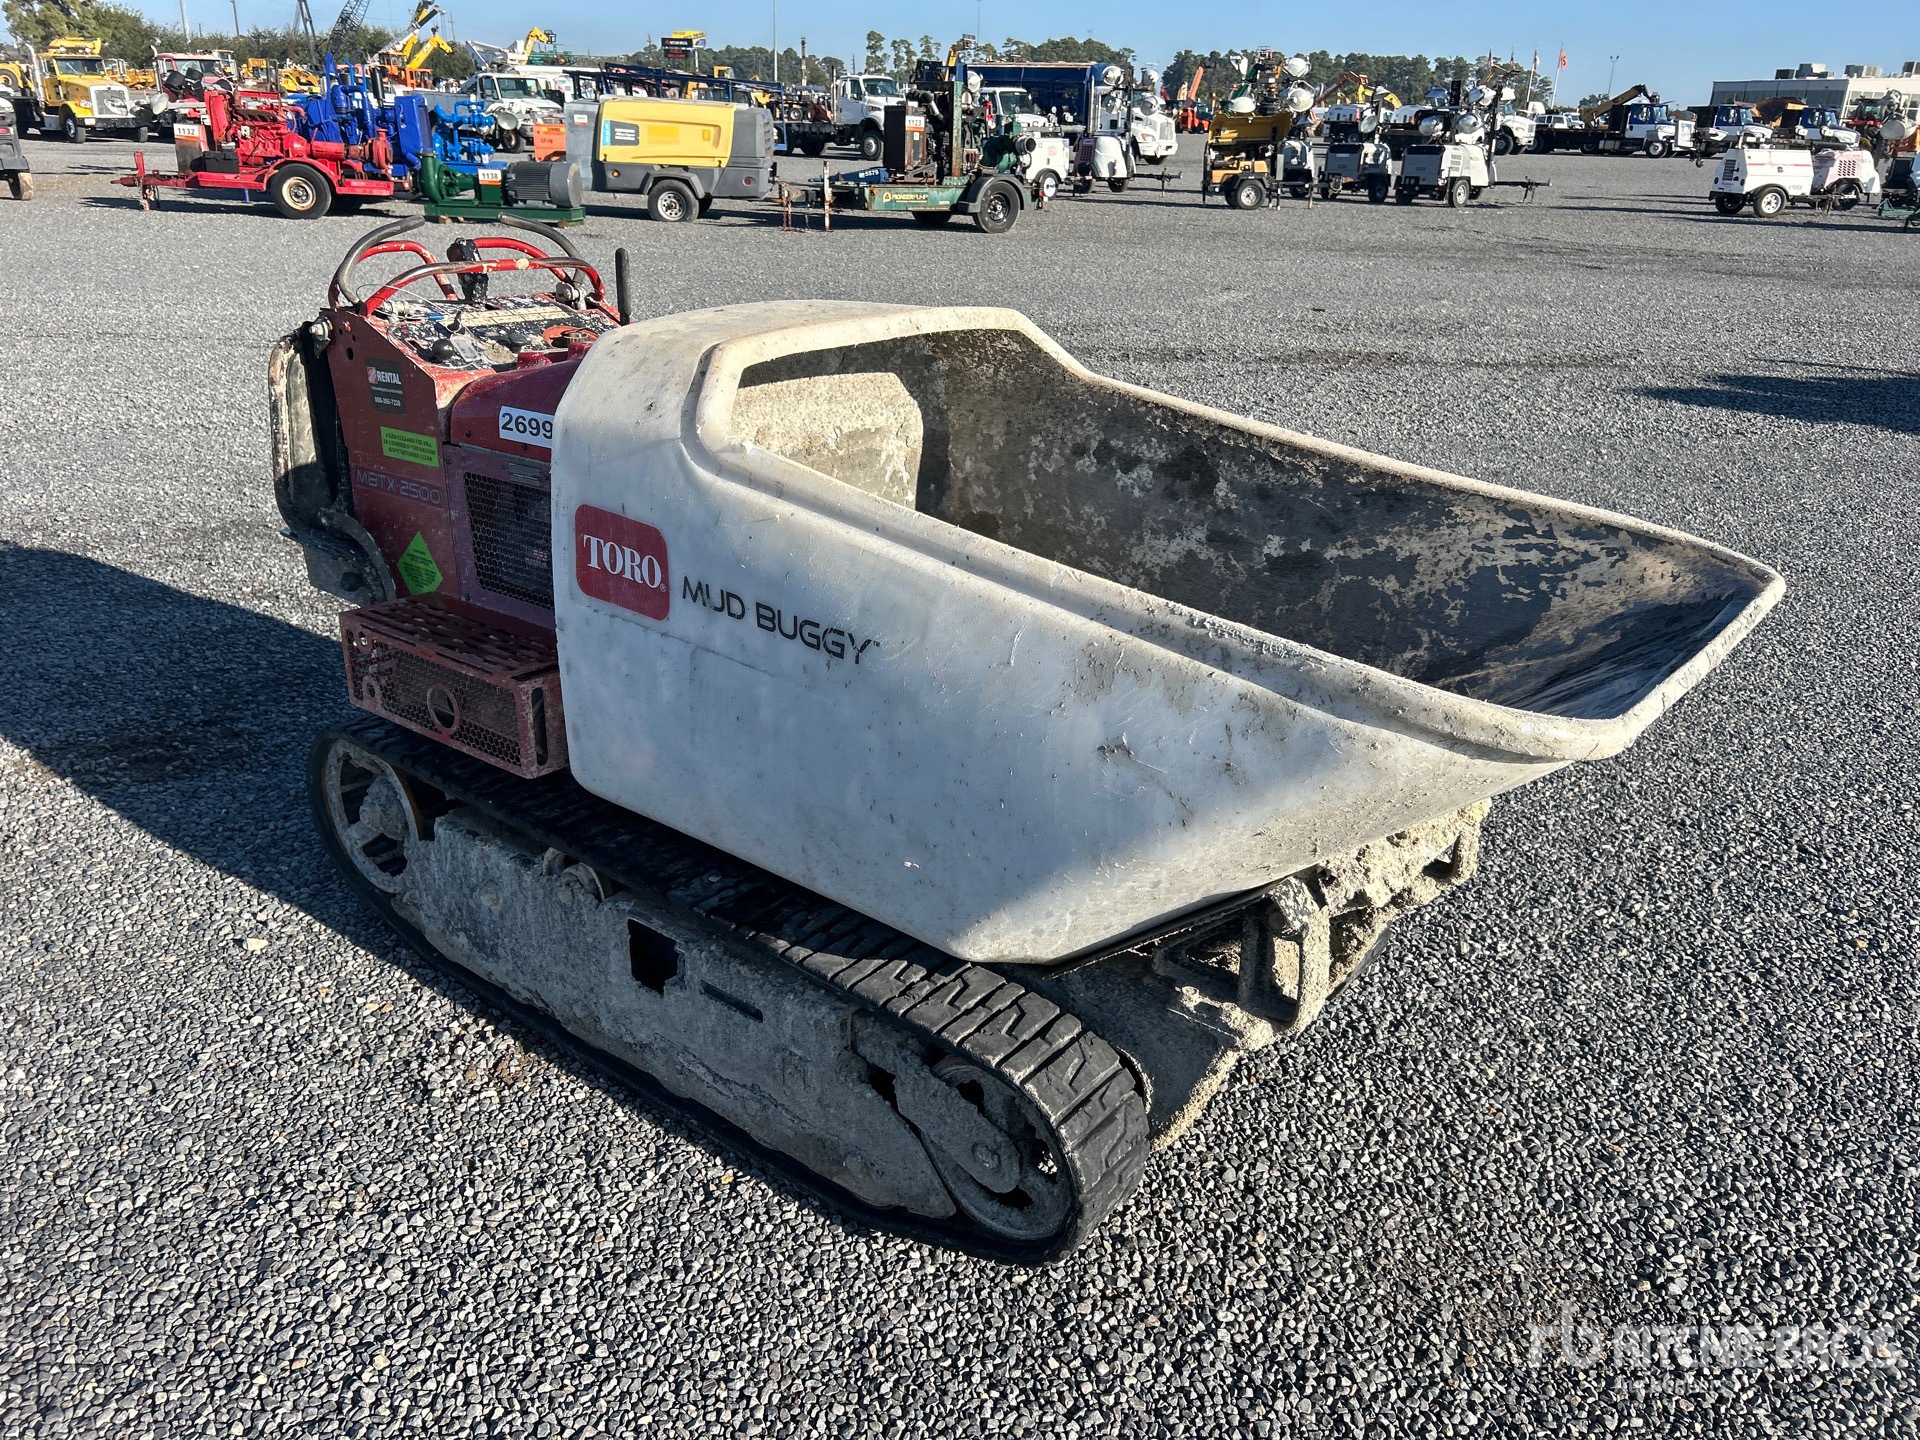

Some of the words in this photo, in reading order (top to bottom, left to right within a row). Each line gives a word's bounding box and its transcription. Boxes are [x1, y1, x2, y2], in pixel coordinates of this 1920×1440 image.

[177, 127, 195, 136] 1132
[481, 172, 499, 180] 1138
[376, 370, 402, 385] RENTAL
[501, 412, 553, 440] 2699
[682, 575, 746, 620] MUD
